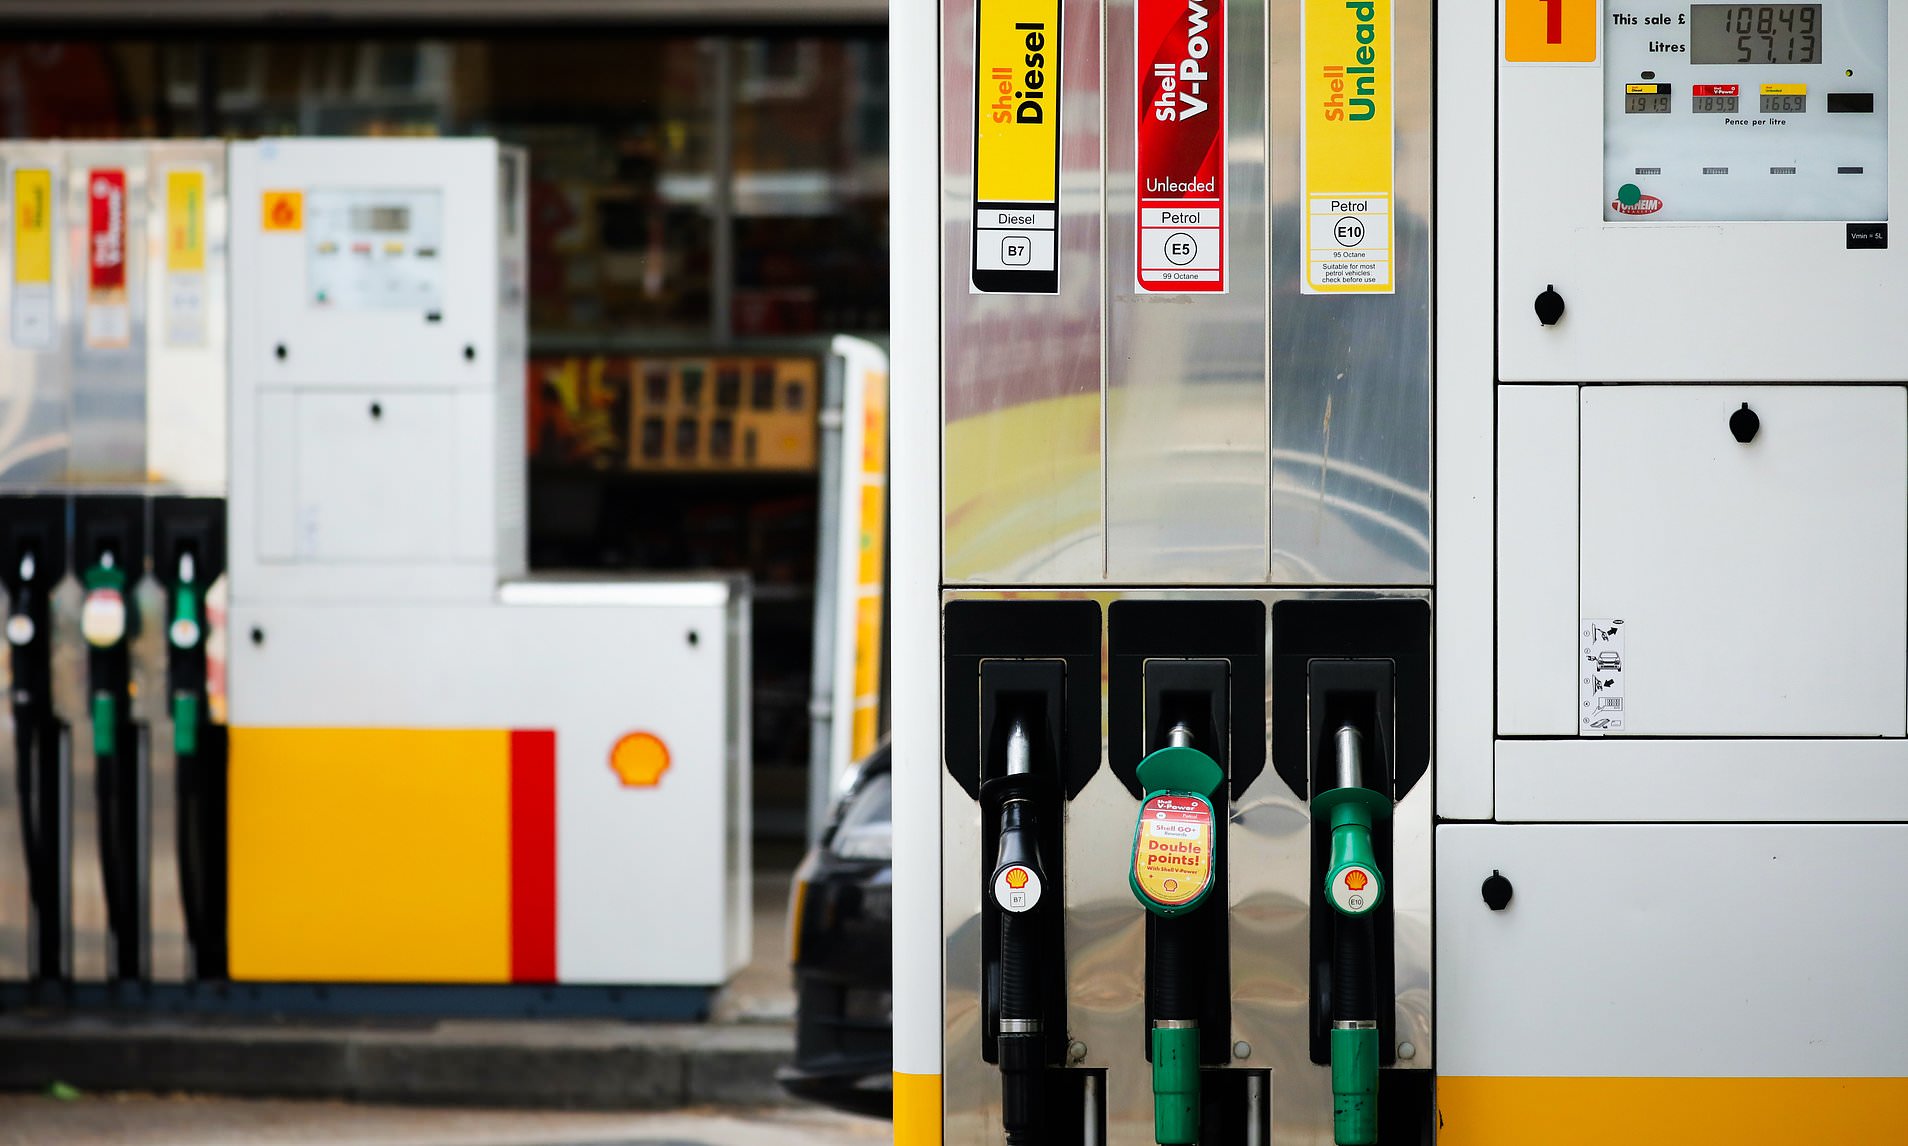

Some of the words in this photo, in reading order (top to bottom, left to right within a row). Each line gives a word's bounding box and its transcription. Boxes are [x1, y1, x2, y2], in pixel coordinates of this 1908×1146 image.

[1613, 14, 1638, 25] This
[1644, 14, 1672, 25] sale
[1678, 14, 1686, 25] £
[1649, 41, 1686, 53] Litres
[1179, 0, 1209, 121] V-Pow
[1015, 22, 1045, 124] Diesel
[992, 67, 1012, 124] Shell
[1154, 63, 1176, 122] Shell
[1323, 66, 1344, 121] Shell
[1752, 119, 1766, 127] per
[1146, 175, 1215, 192] Unleaded
[1331, 200, 1368, 212] Petrol
[998, 213, 1035, 225] Diesel
[1162, 211, 1200, 224] Petrol
[1338, 226, 1362, 238] E10
[1008, 245, 1025, 256] B7
[1172, 243, 1190, 255] E5
[1162, 272, 1172, 280] 99
[1173, 272, 1199, 280] Octane
[1325, 270, 1344, 278] petrol
[1156, 824, 1176, 832] Shell
[1148, 839, 1202, 854] Double
[1147, 852, 1200, 866] points!
[1350, 898, 1362, 906] E10
